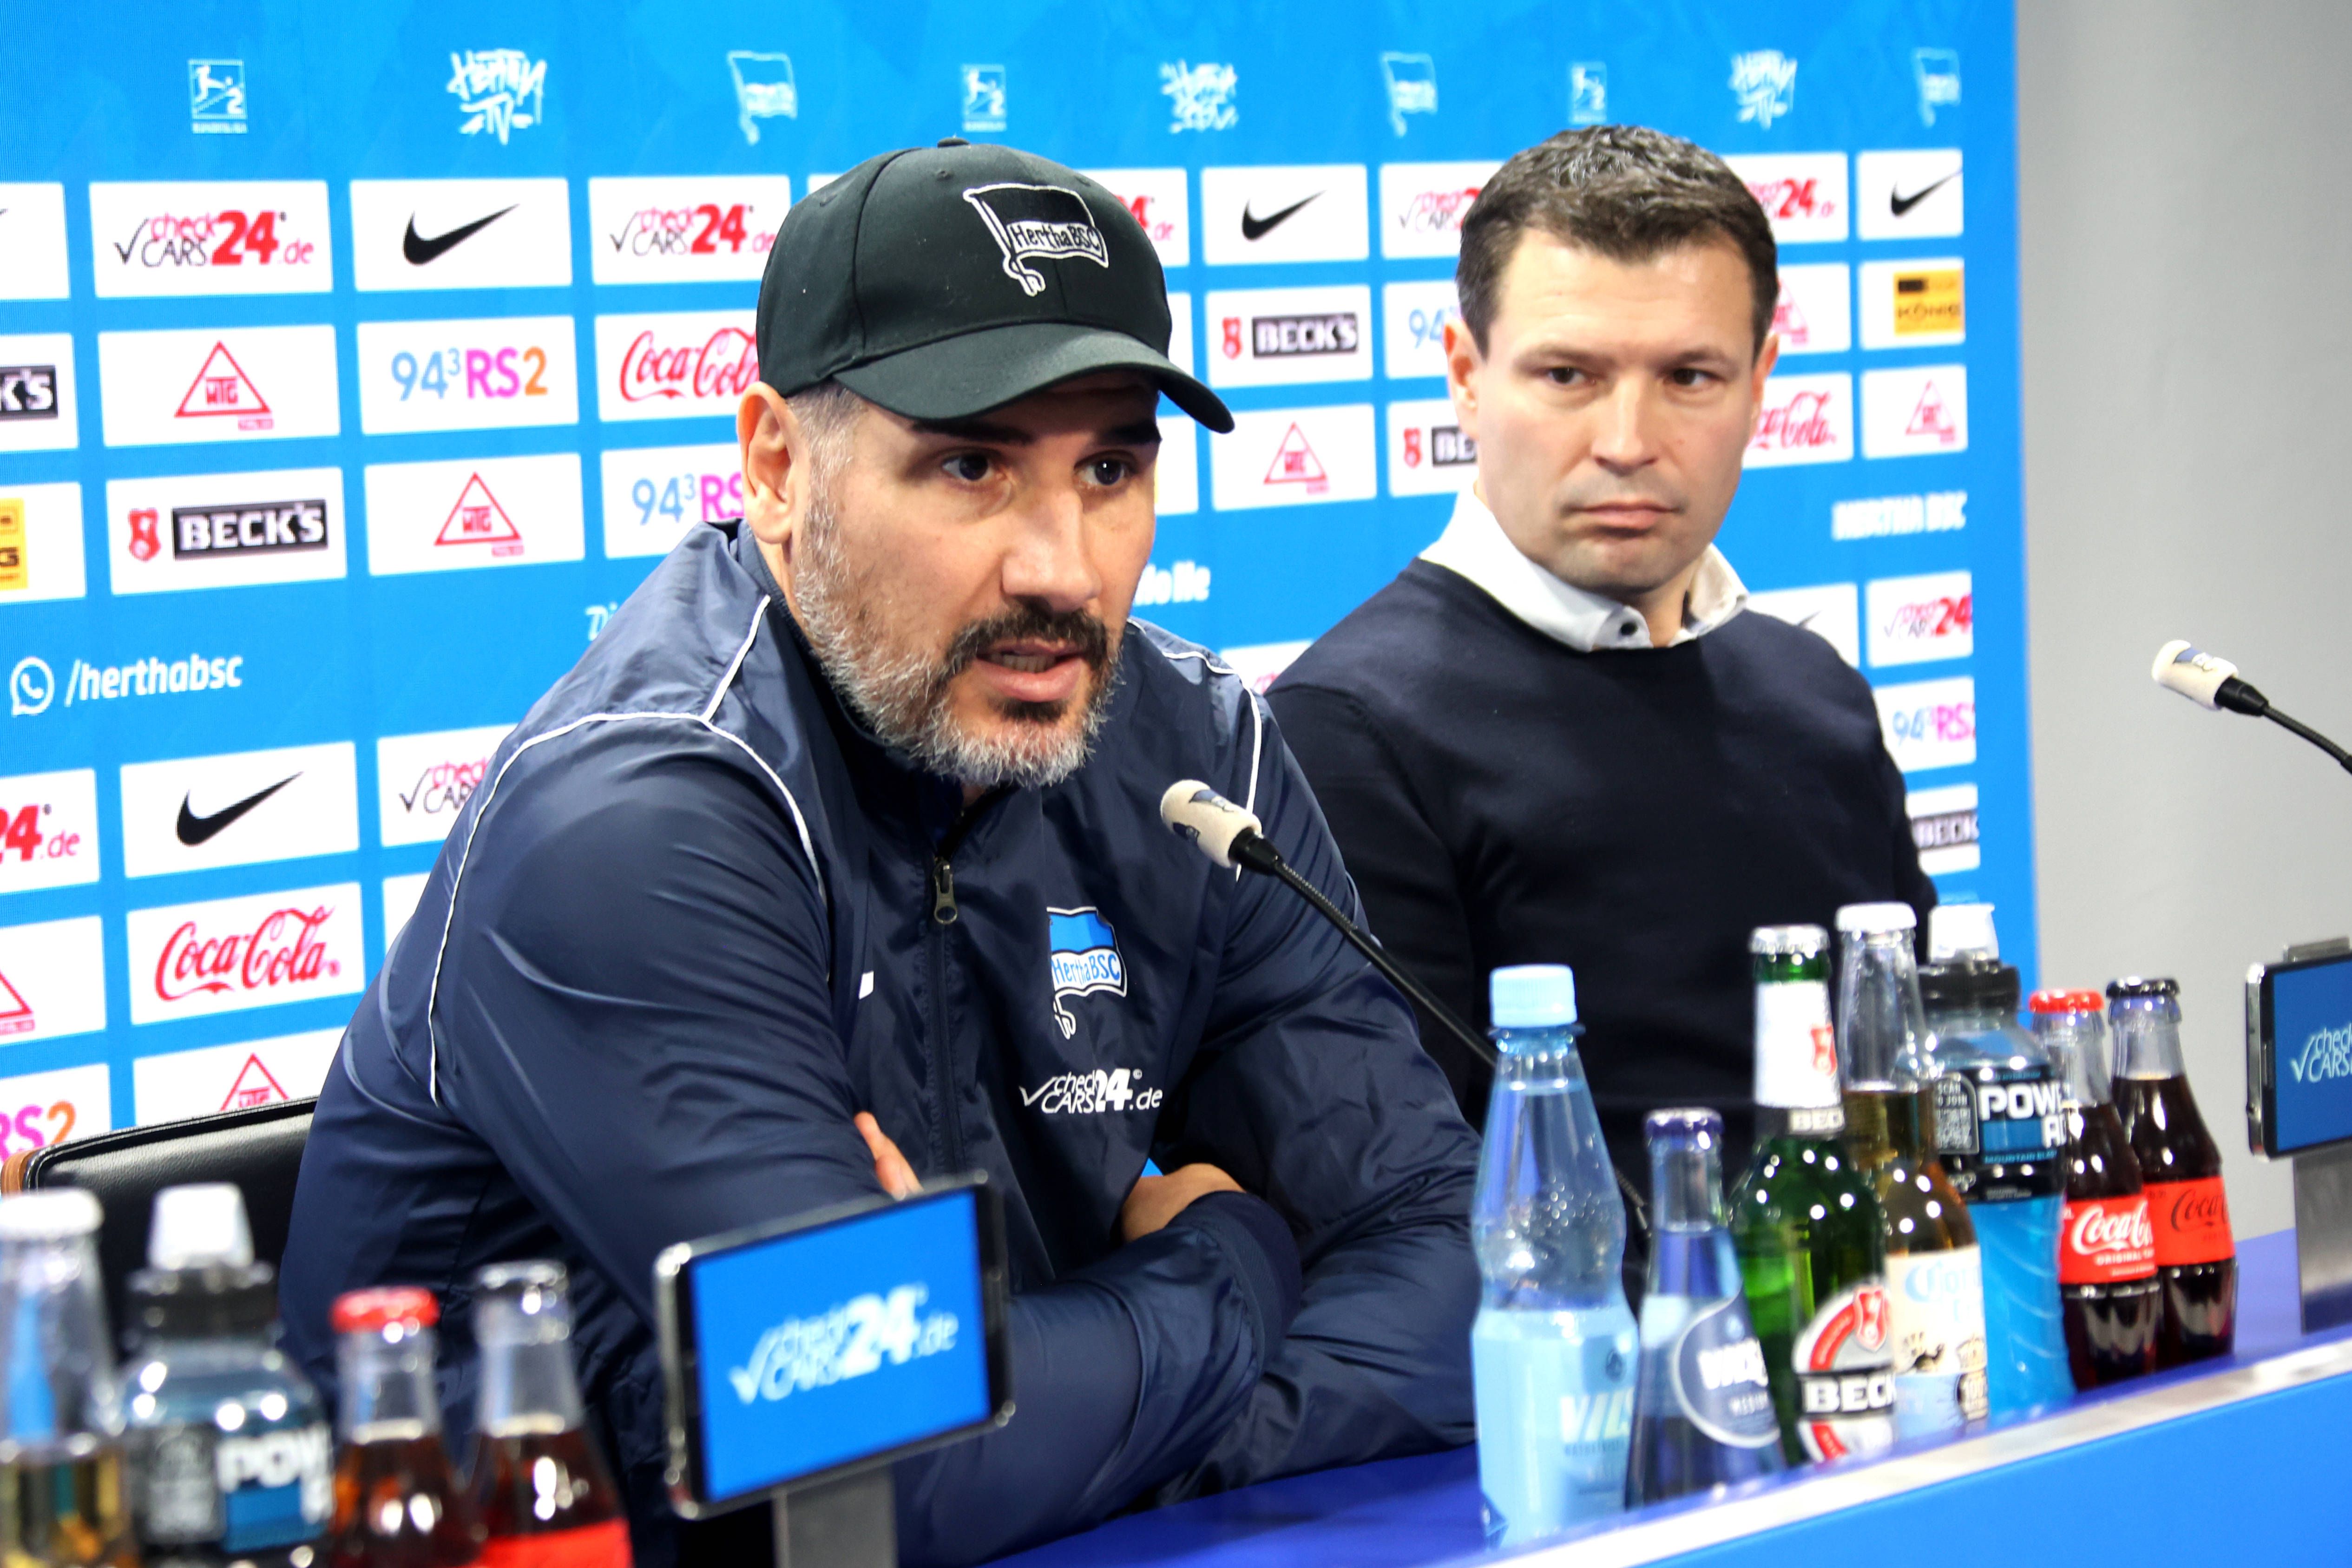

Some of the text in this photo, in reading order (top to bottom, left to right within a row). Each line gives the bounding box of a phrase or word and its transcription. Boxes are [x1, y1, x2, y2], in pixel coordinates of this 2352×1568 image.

[619, 328, 759, 402] Coca-Col
[177, 502, 325, 551] BECK'S
[155, 905, 335, 1001] Coca-Cola
